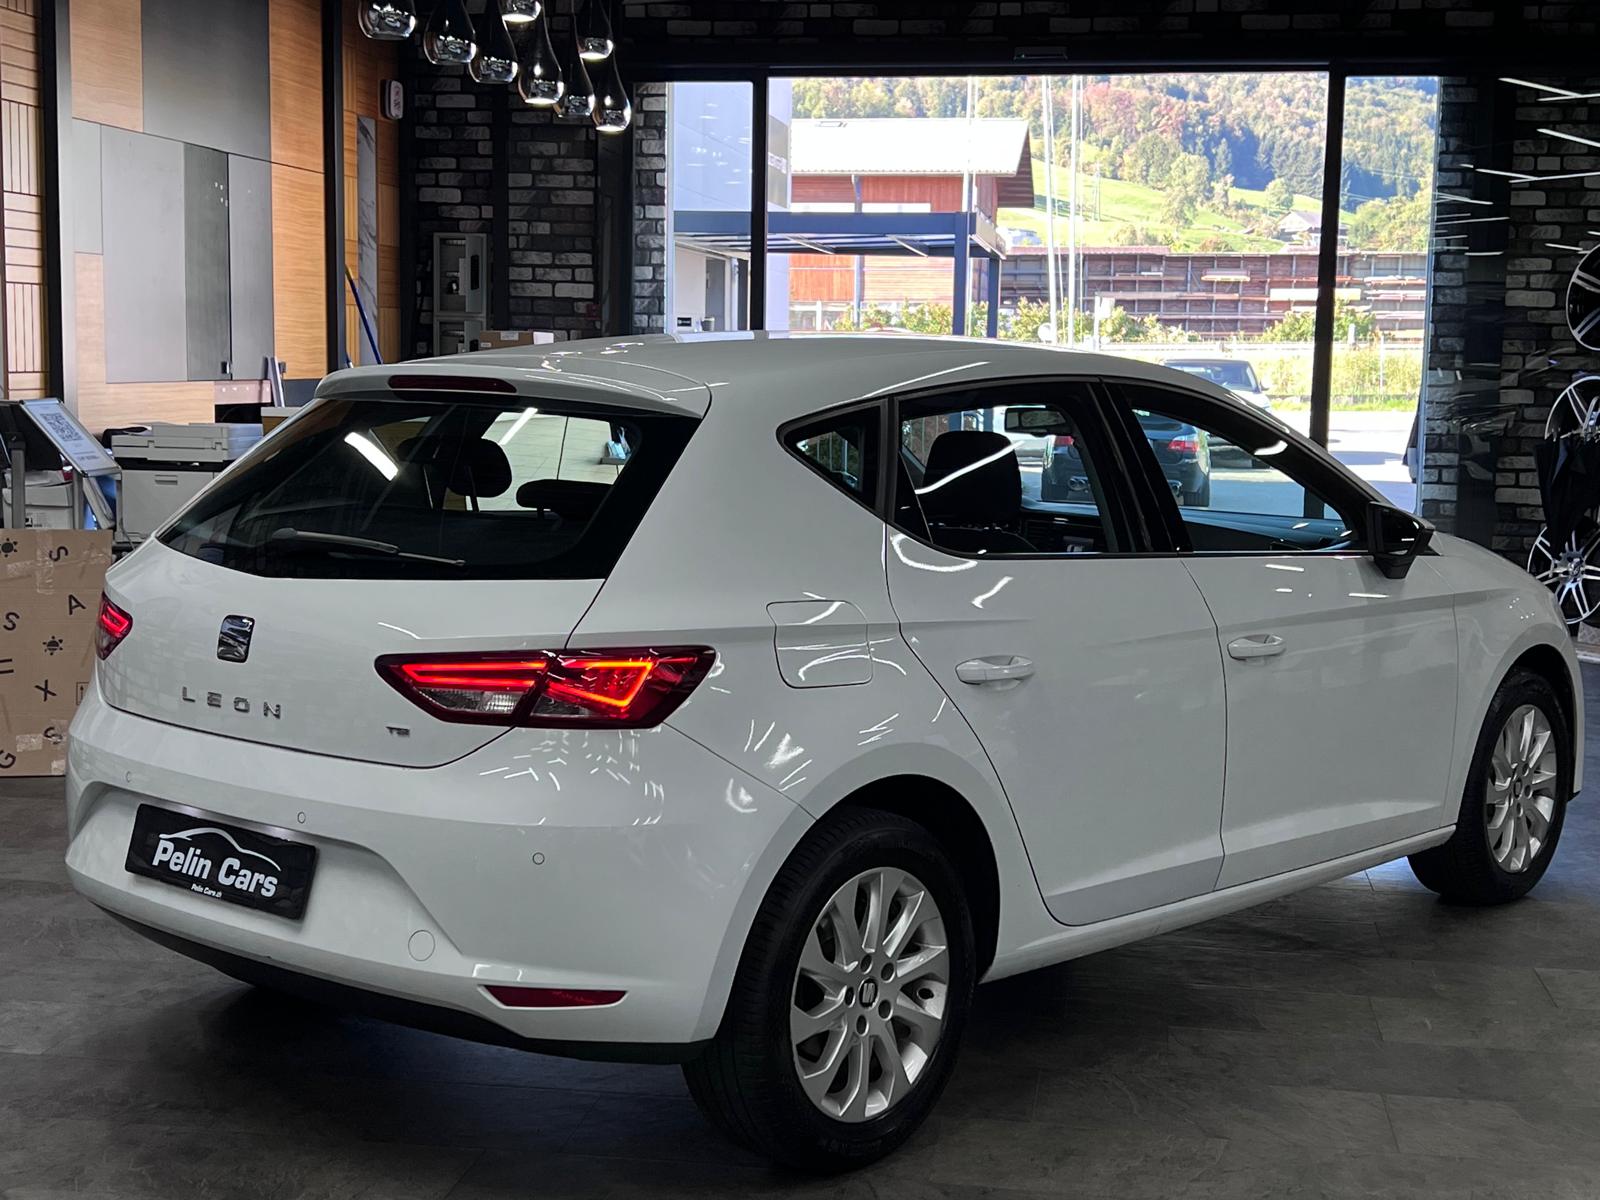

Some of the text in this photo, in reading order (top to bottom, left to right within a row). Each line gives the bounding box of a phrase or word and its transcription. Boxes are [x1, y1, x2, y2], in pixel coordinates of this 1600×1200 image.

[67, 594, 87, 616] A
[3, 611, 20, 631] S
[34, 679, 57, 702] X
[181, 686, 281, 719] LEON
[151, 839, 278, 898] Pelin Cars
